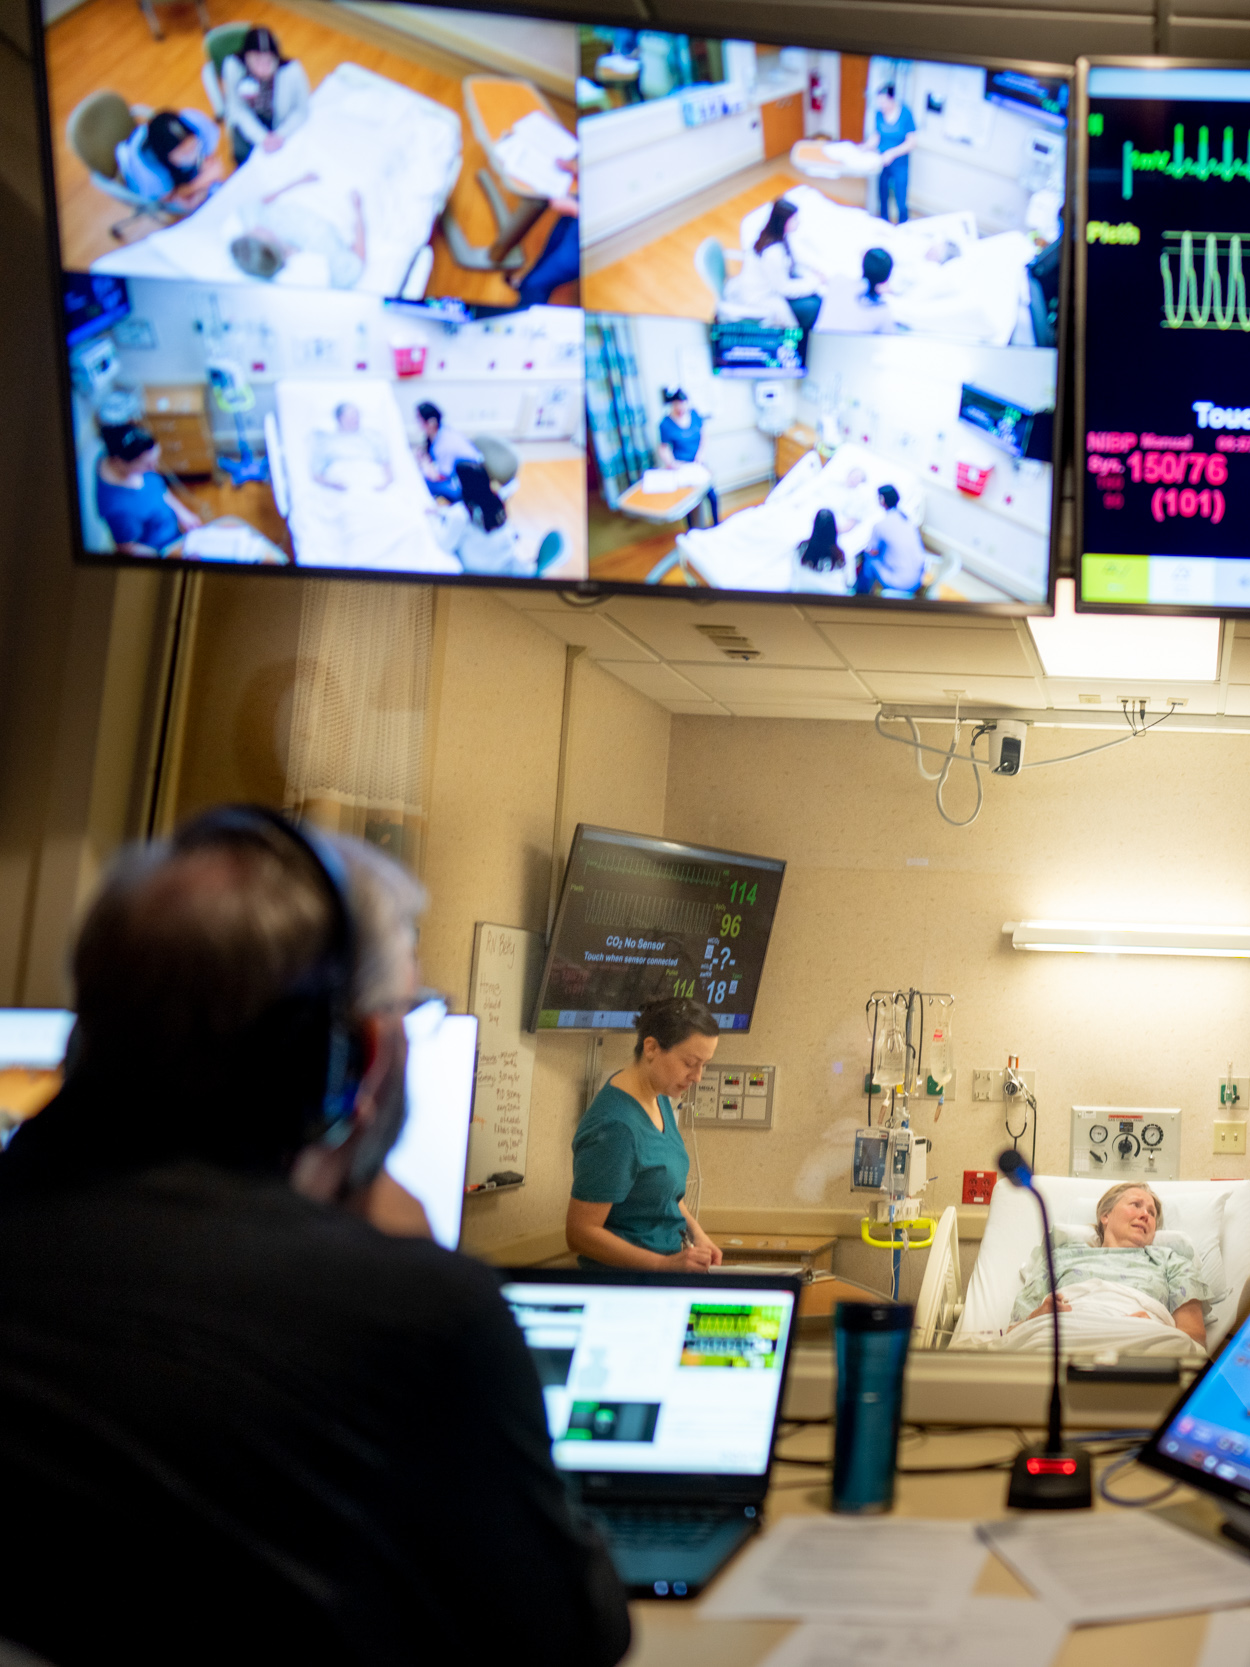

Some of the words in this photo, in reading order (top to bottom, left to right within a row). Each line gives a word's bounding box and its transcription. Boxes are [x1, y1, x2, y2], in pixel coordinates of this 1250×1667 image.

[1086, 221, 1141, 246] Pleth
[1126, 450, 1229, 487] 150/76
[1151, 486, 1226, 525] (101)
[730, 881, 758, 906] 114
[720, 913, 742, 938] 96
[624, 937, 636, 948] No
[637, 938, 666, 951] Sensor
[584, 951, 604, 961] Touch
[605, 953, 623, 963] when
[624, 955, 647, 965] sensor
[646, 957, 679, 967] connected
[673, 979, 696, 998] 114
[707, 980, 727, 1004] 18
